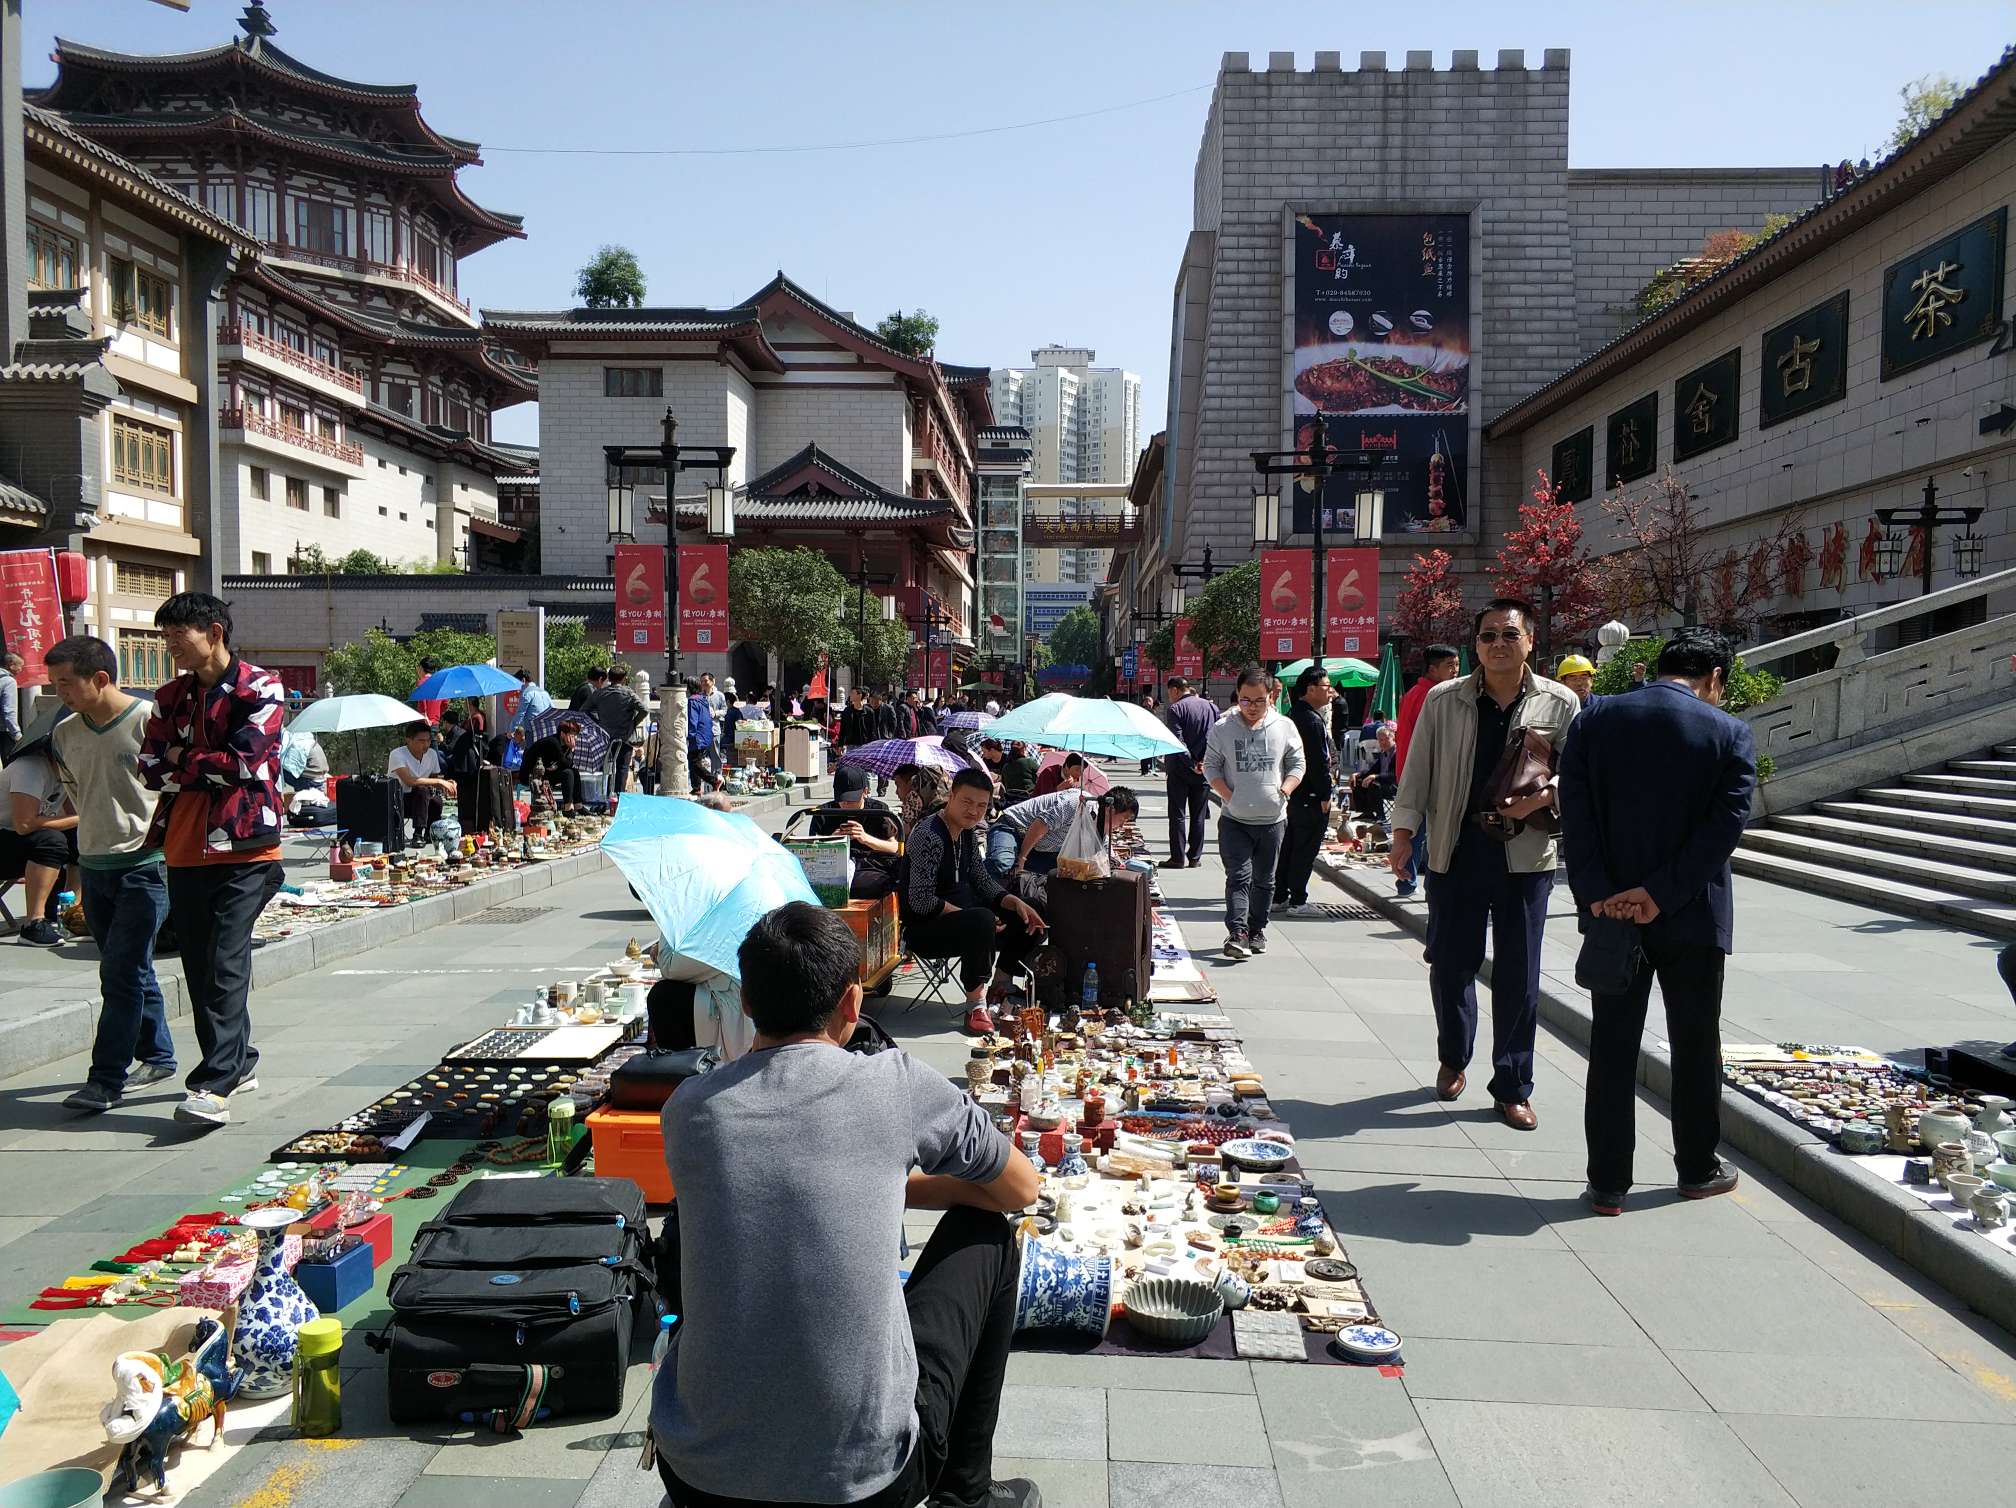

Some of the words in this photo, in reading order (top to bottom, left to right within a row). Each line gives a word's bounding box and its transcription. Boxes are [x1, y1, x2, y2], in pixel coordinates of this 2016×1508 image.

[1777, 334, 1822, 398] 古
[1903, 260, 1968, 342] 茶
[626, 562, 651, 604] 6
[689, 562, 716, 604] 6
[1270, 569, 1297, 613] 6
[1337, 568, 1365, 611] 6
